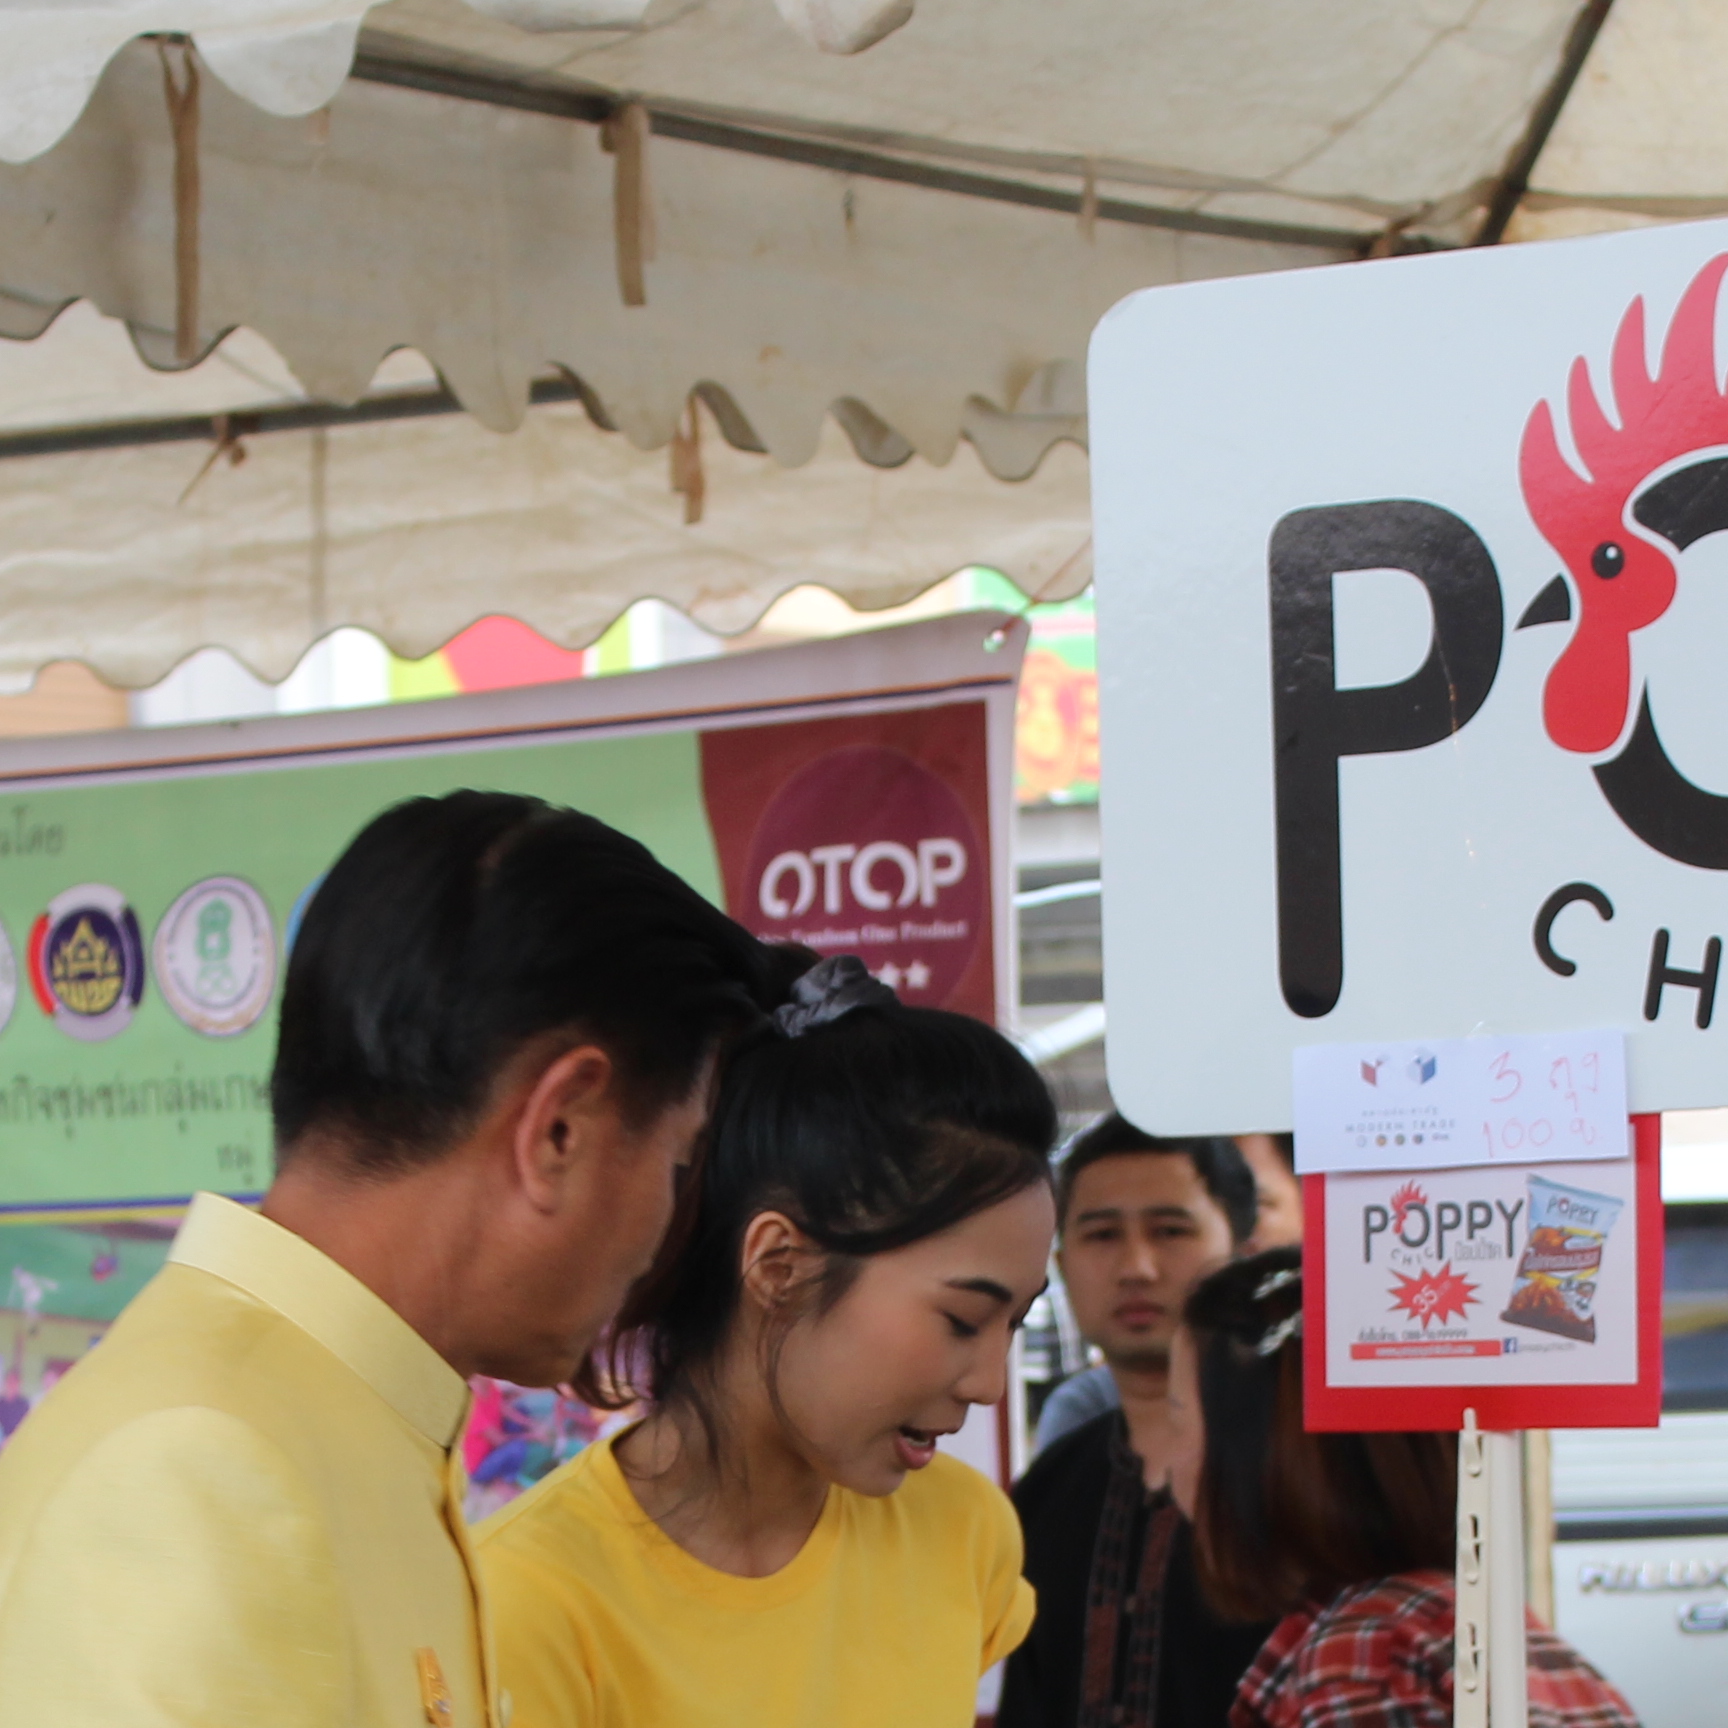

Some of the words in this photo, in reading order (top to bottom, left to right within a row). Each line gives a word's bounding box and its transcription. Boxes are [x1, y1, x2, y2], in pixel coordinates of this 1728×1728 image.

[758, 837, 968, 920] OTOP
[1488, 1050, 1524, 1104] 3
[1482, 1117, 1554, 1159] 100
[1362, 1198, 1526, 1263] POPPY
[1546, 1197, 1598, 1225] POPPY
[1412, 1283, 1438, 1316] 35
